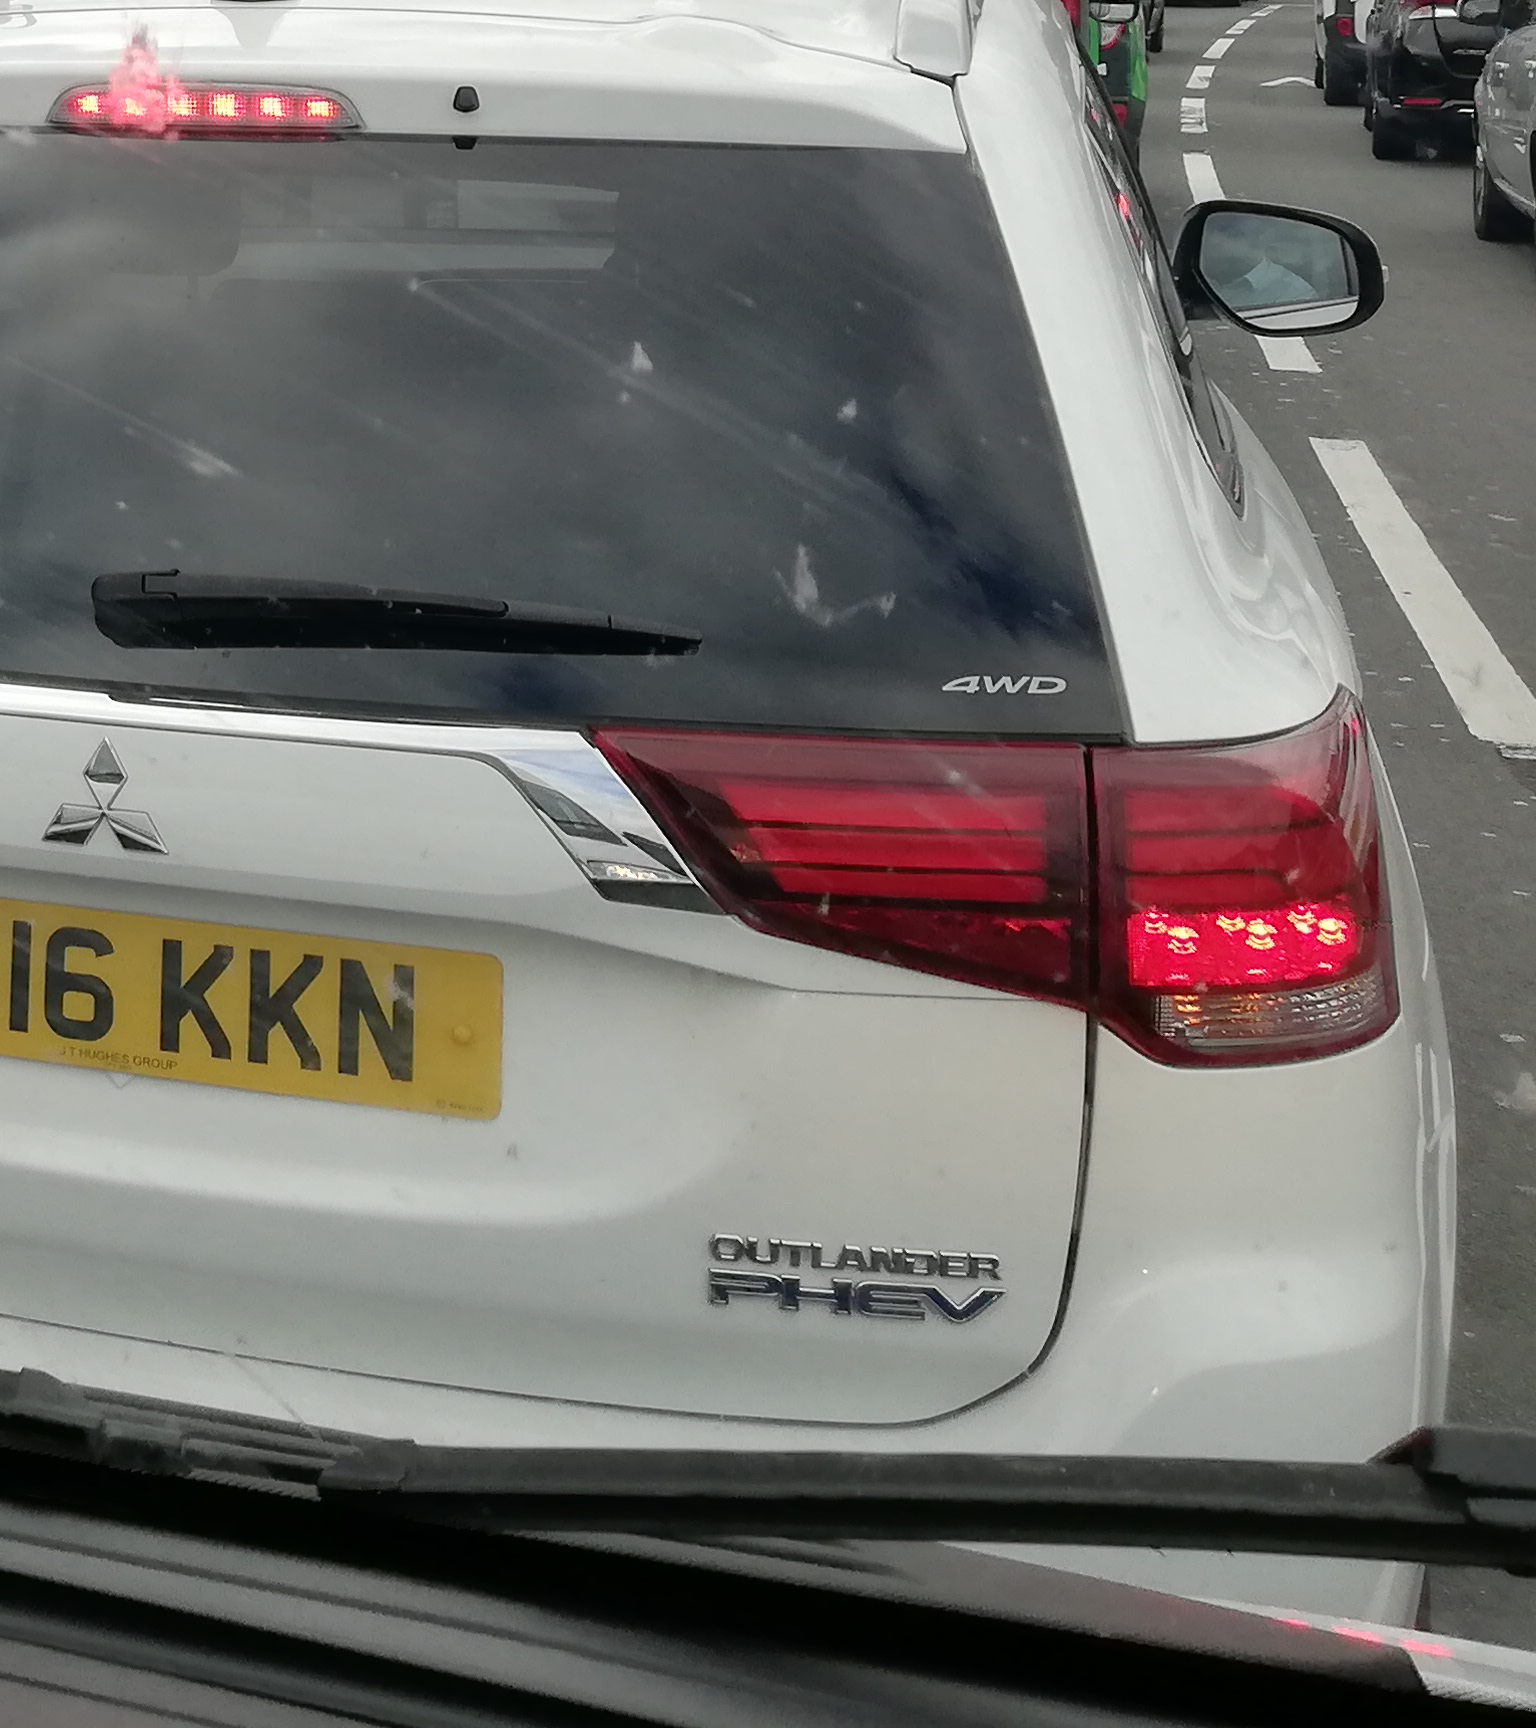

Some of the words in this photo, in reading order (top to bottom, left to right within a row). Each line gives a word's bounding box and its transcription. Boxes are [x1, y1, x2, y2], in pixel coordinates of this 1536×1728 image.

[941, 674, 1068, 694] 4WD
[159, 937, 416, 1083] KKN
[78, 1047, 130, 1065] HUGHES
[132, 1055, 178, 1071] GROUP
[707, 1232, 1003, 1281] OUTLANDER
[706, 1267, 1008, 1323] PHEV
